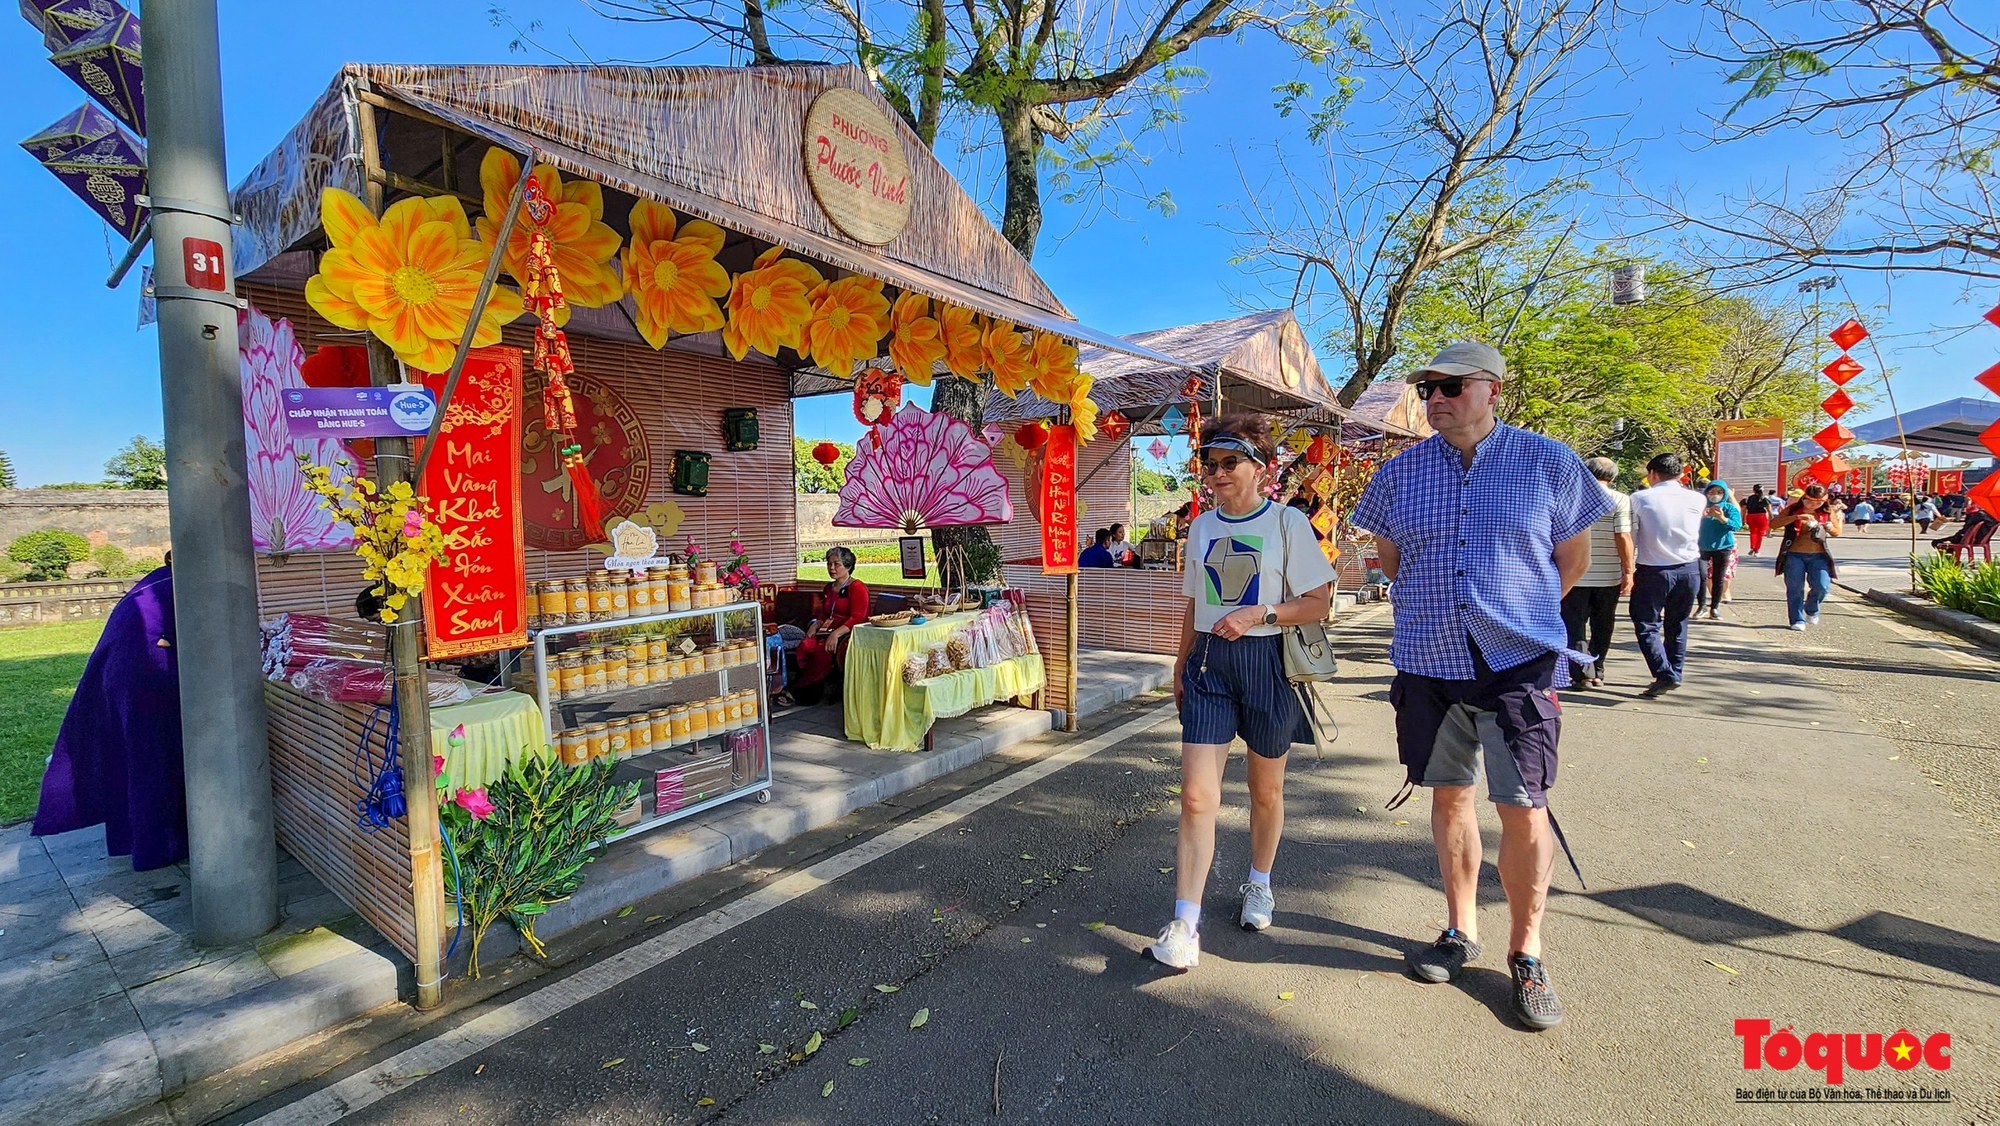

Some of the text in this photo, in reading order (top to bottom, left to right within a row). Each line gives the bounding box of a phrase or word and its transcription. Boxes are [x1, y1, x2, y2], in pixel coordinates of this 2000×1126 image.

[831, 113, 890, 154] PHƯỜNG
[816, 135, 906, 205] Phước Vĩnh
[192, 252, 220, 274] 31
[288, 406, 388, 418] CHẤP NHẬN THANH TOÁN
[400, 401, 425, 409] Hue-S
[317, 417, 366, 428] BẰNG HUE-S
[447, 440, 492, 469] Mai
[443, 468, 498, 507] Vàng
[435, 497, 503, 523] Khoe
[449, 525, 494, 550] Sắc
[454, 552, 493, 578] Đón
[441, 581, 506, 609] Xuân
[449, 609, 503, 635] Sang
